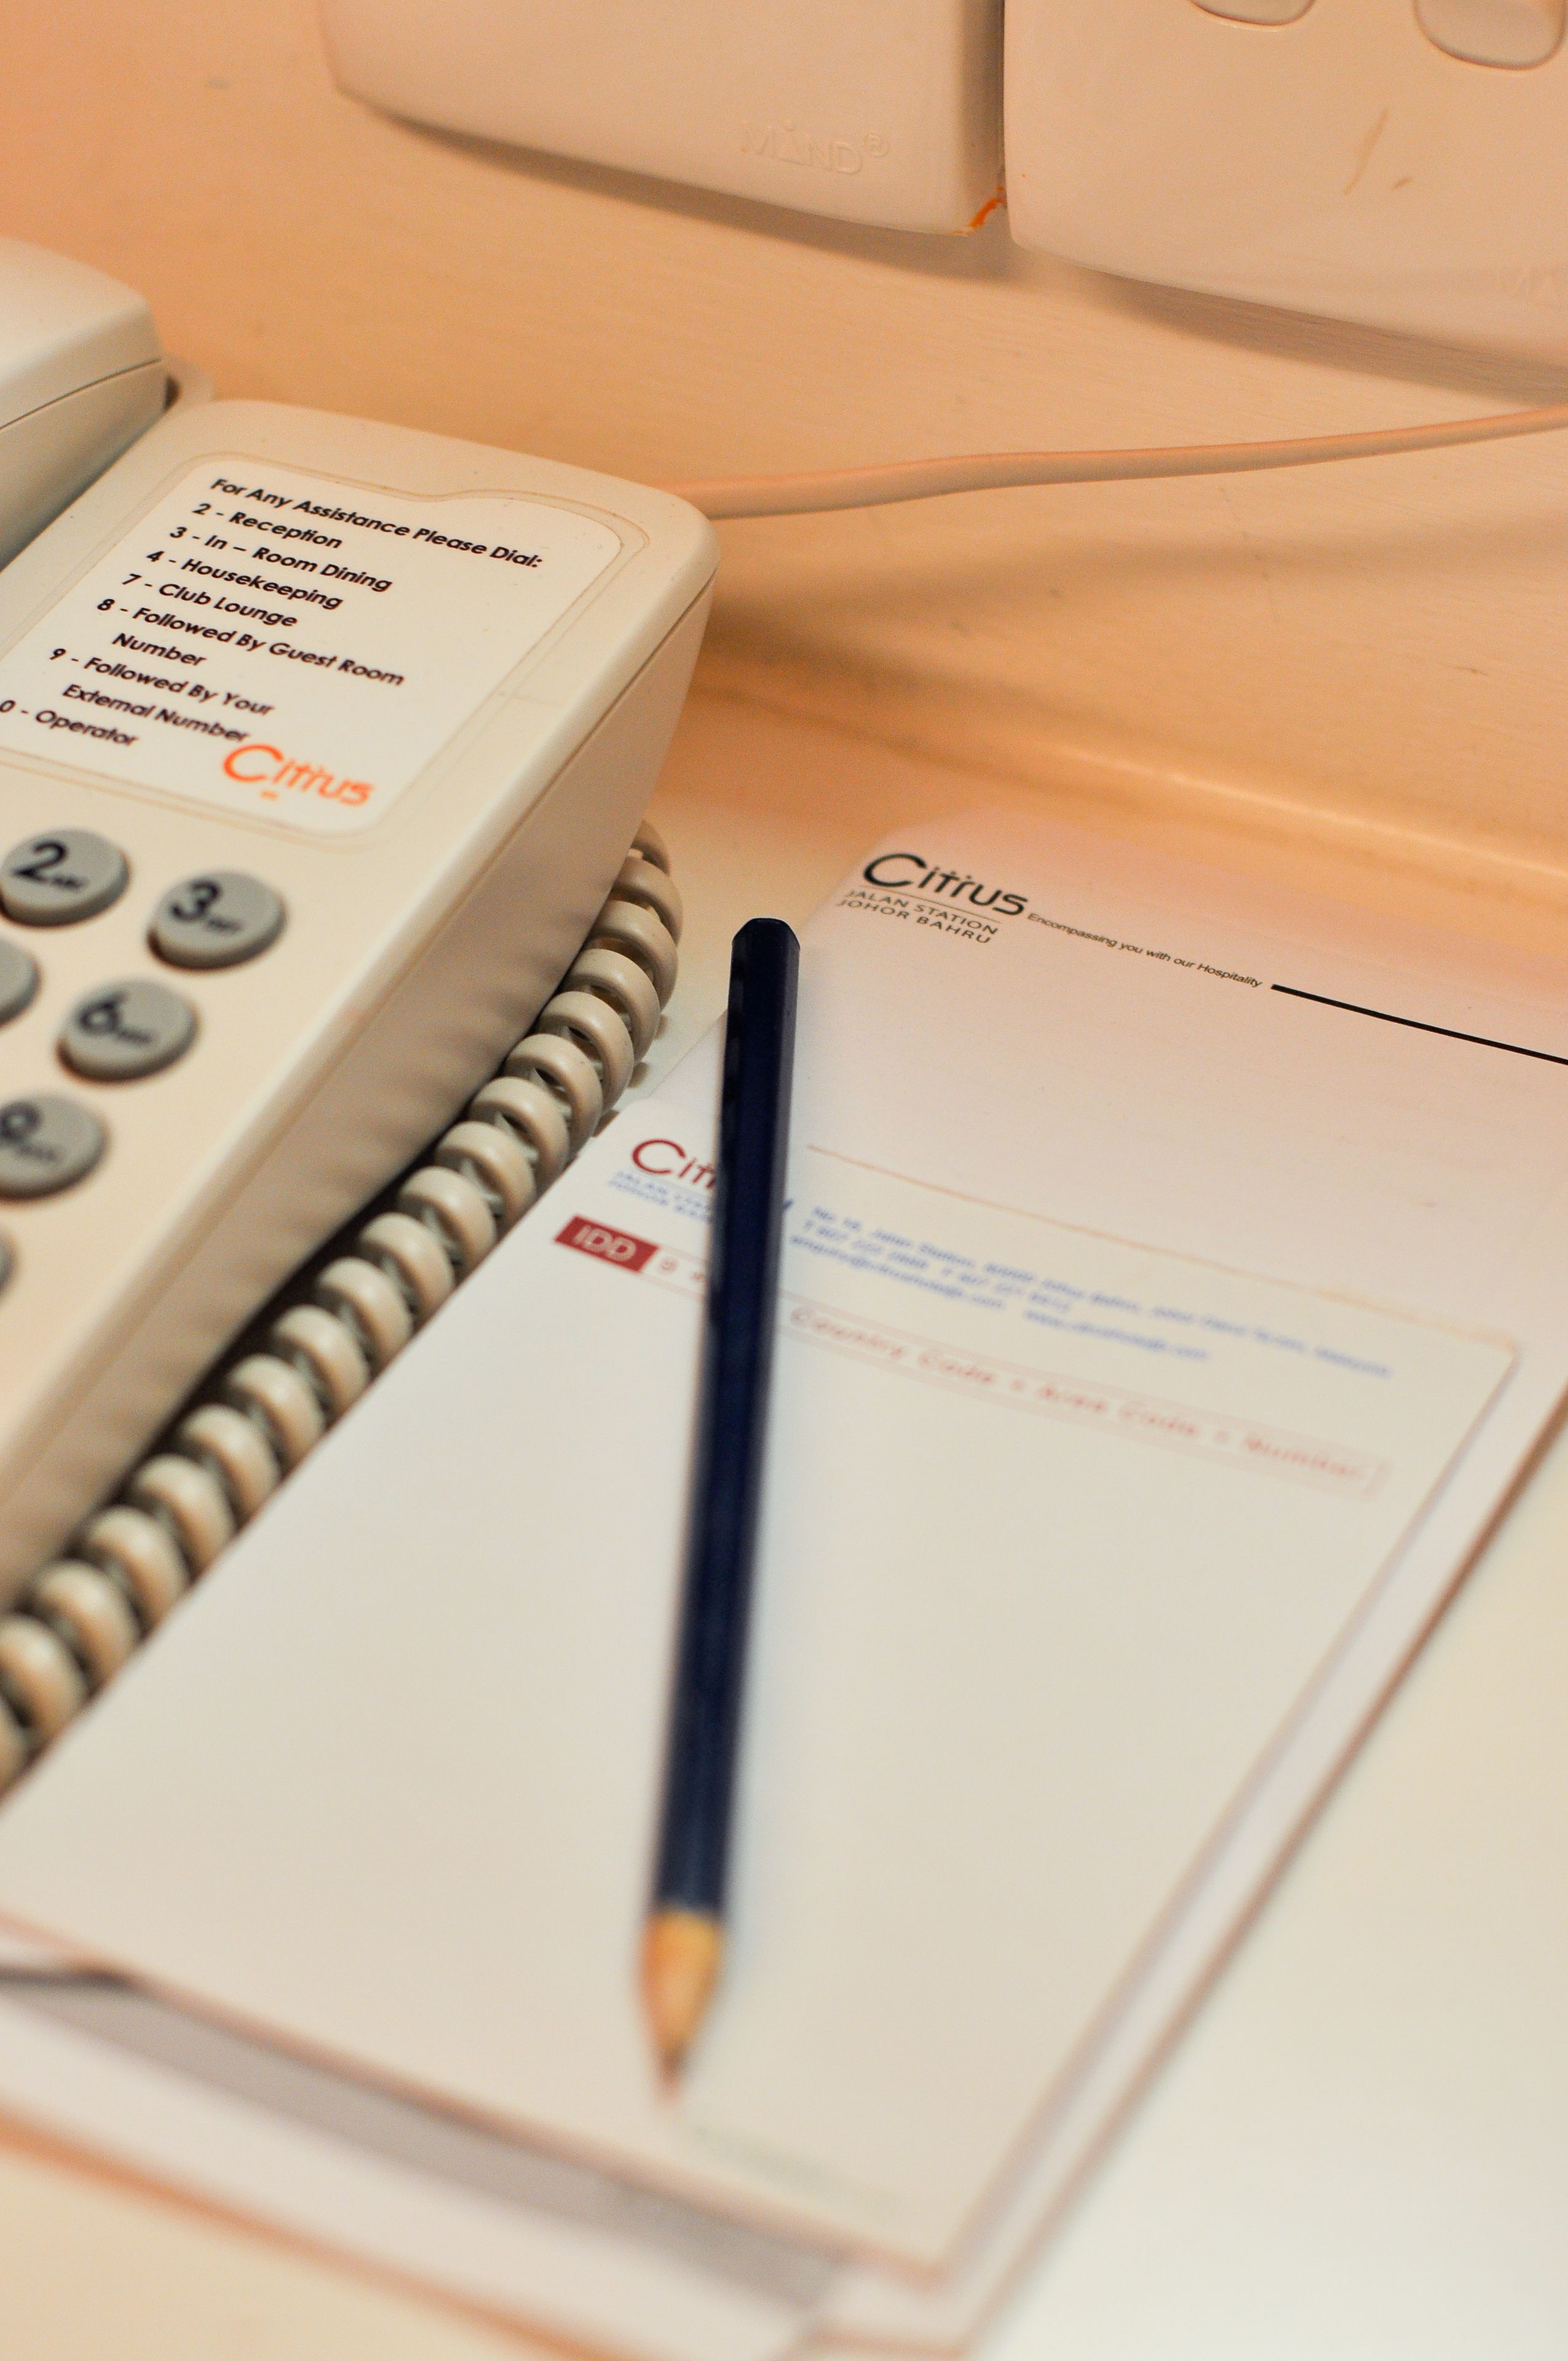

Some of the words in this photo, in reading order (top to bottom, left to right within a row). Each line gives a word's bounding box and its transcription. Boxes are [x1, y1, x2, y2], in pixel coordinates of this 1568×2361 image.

[192, 503, 212, 515] 2
[229, 512, 343, 548] Reception
[211, 478, 247, 495] For
[245, 488, 293, 508] Any
[293, 500, 410, 536] Assistance
[413, 528, 487, 554] Please
[489, 546, 542, 568] Dial:
[146, 550, 165, 562] 4
[181, 558, 343, 610] Housekeeping
[170, 526, 188, 539] 3
[205, 534, 228, 550] In
[252, 547, 318, 572] Room
[320, 564, 393, 592] Dining
[122, 573, 142, 585] 7
[159, 583, 212, 606] Club
[213, 597, 298, 627] Lounge
[97, 598, 115, 611] 8
[132, 607, 237, 643] Followed
[235, 634, 267, 652] By
[269, 643, 338, 668] Guest
[338, 659, 405, 686] Room
[111, 633, 207, 666] Number
[49, 648, 66, 660] 9
[84, 657, 189, 693] Followed
[188, 684, 218, 703] By
[223, 692, 275, 716] Your
[35, 710, 140, 746] Operator
[62, 684, 157, 718] External
[154, 708, 250, 742] Number
[222, 743, 374, 805] Citrus
[12, 841, 66, 884] 2
[863, 853, 1029, 916] Citrus
[169, 879, 220, 922] 3
[836, 899, 910, 920] JOHOR
[916, 916, 992, 944] BAHRU
[844, 890, 909, 908] JALAN
[914, 904, 998, 935] STATION
[1028, 912, 1117, 948] Encompassing
[1119, 941, 1144, 954] you
[1146, 948, 1171, 962] with
[1173, 957, 1195, 968] our
[1197, 963, 1262, 989] Hospitality
[572, 1225, 637, 1262] IDD
